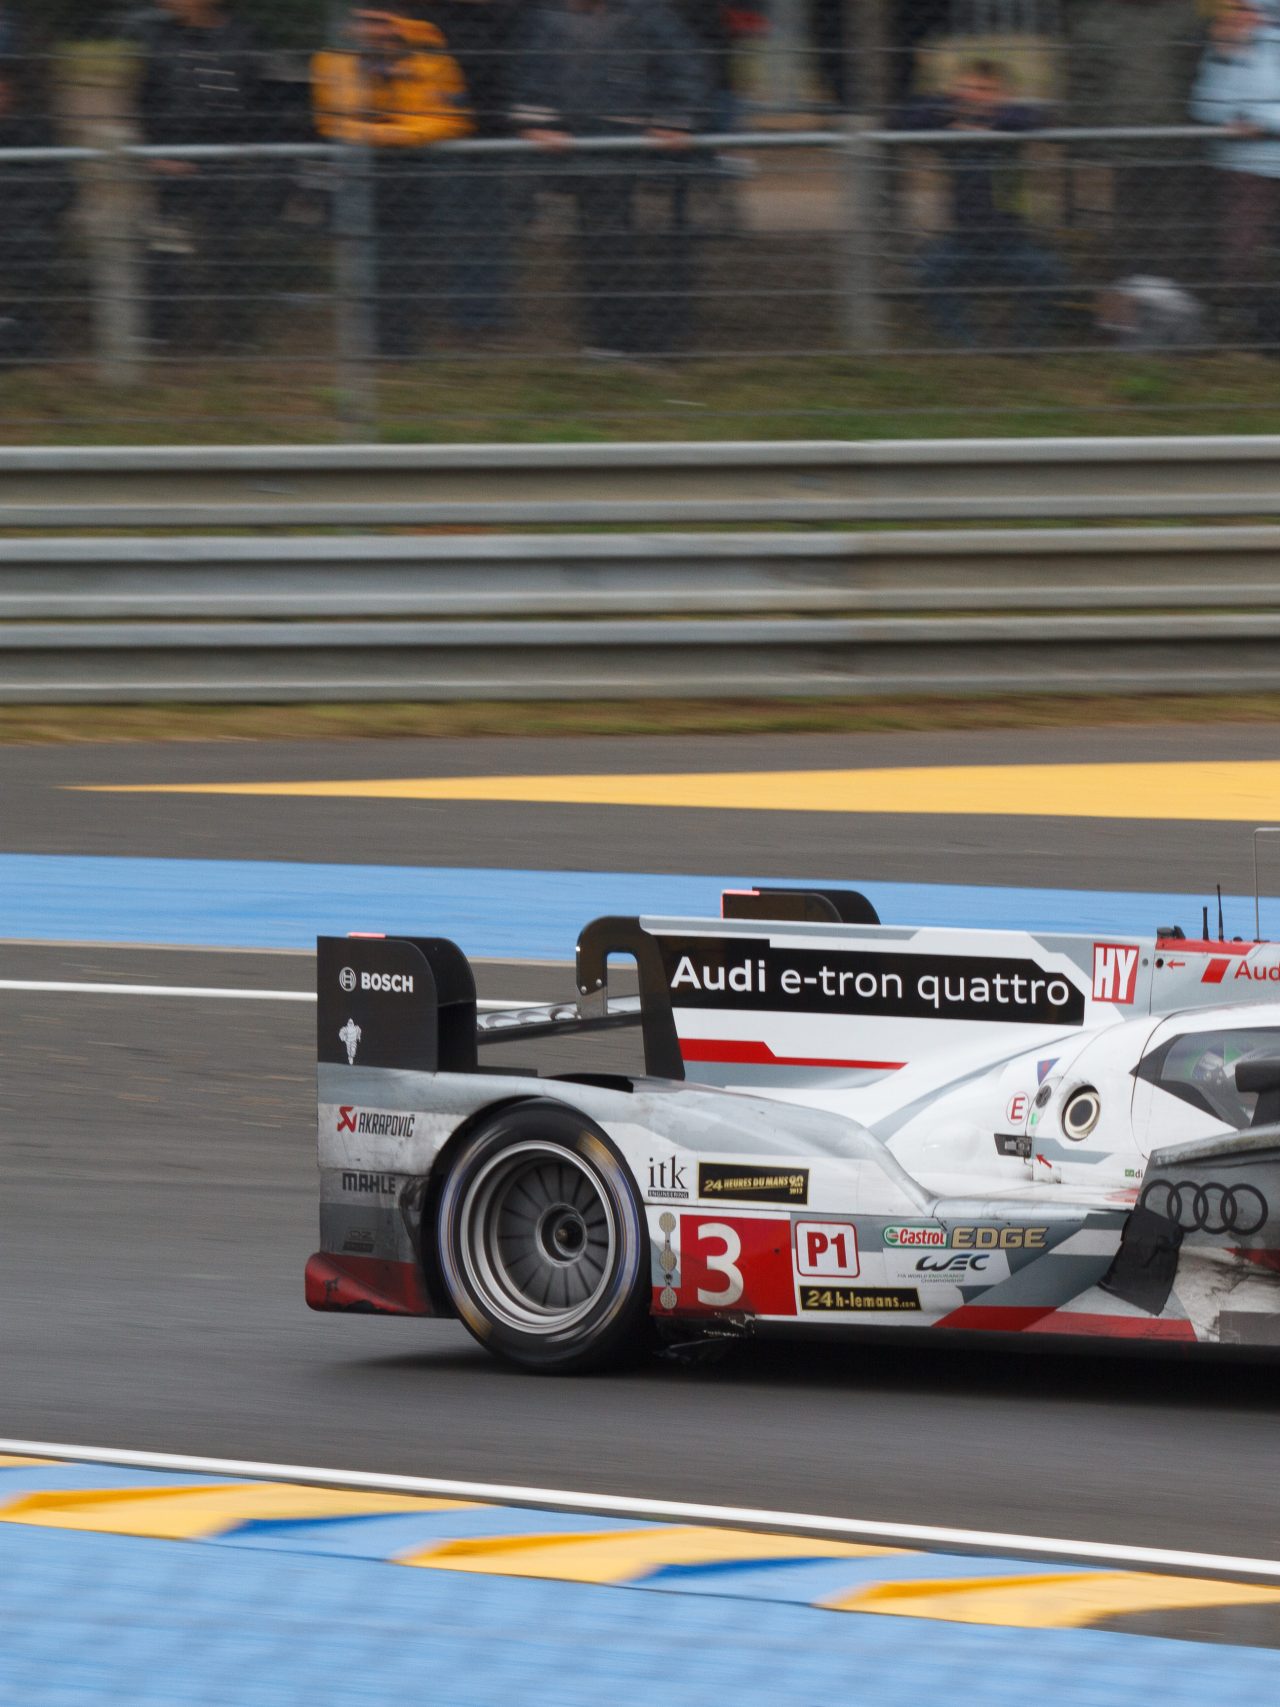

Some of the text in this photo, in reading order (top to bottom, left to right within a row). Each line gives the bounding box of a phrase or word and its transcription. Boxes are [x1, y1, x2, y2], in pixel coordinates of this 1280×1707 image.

[361, 972, 414, 993] BOSCH
[670, 956, 1069, 1008] Audi e-tron quattro
[1093, 946, 1137, 1000] HY
[1010, 1097, 1025, 1120] E
[648, 1154, 687, 1189] itk
[342, 1172, 396, 1195] MAHLE
[703, 1176, 788, 1192] 24 HEURES DU MANS
[900, 1226, 1048, 1249] Castrol EDGE
[807, 1231, 847, 1268] P1
[697, 1222, 745, 1307] 3
[915, 1252, 990, 1271] WEC
